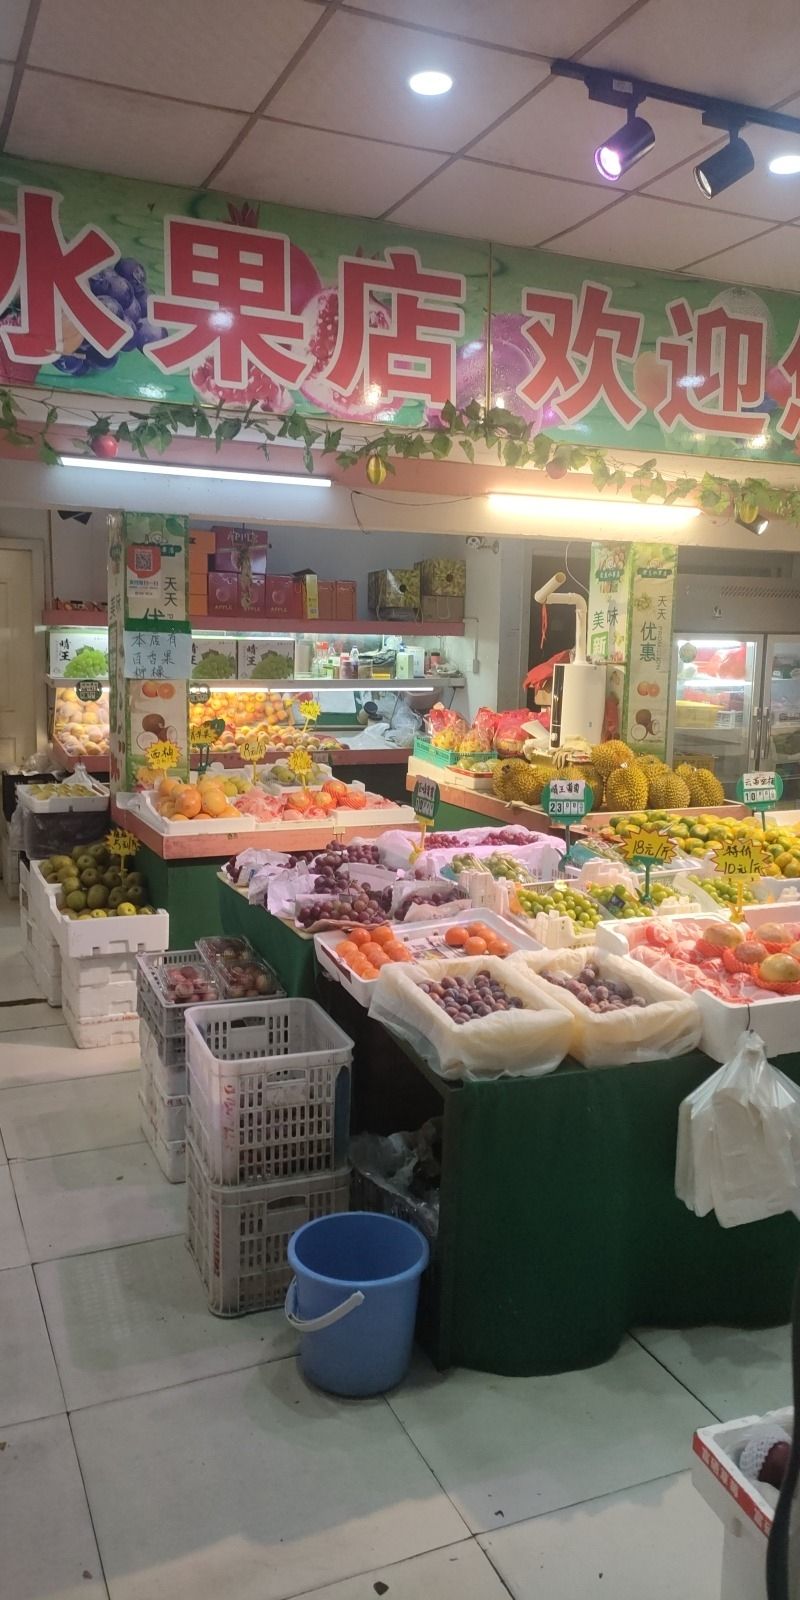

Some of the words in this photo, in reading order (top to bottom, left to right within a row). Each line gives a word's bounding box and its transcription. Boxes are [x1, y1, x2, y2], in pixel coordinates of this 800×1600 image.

[0, 190, 466, 408] 水果店
[164, 577, 178, 607] 天天
[591, 605, 619, 631] 美味
[657, 595, 669, 620] 天天
[640, 620, 657, 662] 优惠
[633, 840, 669, 859] 18元/斤
[724, 859, 764, 875] 10元/斤
